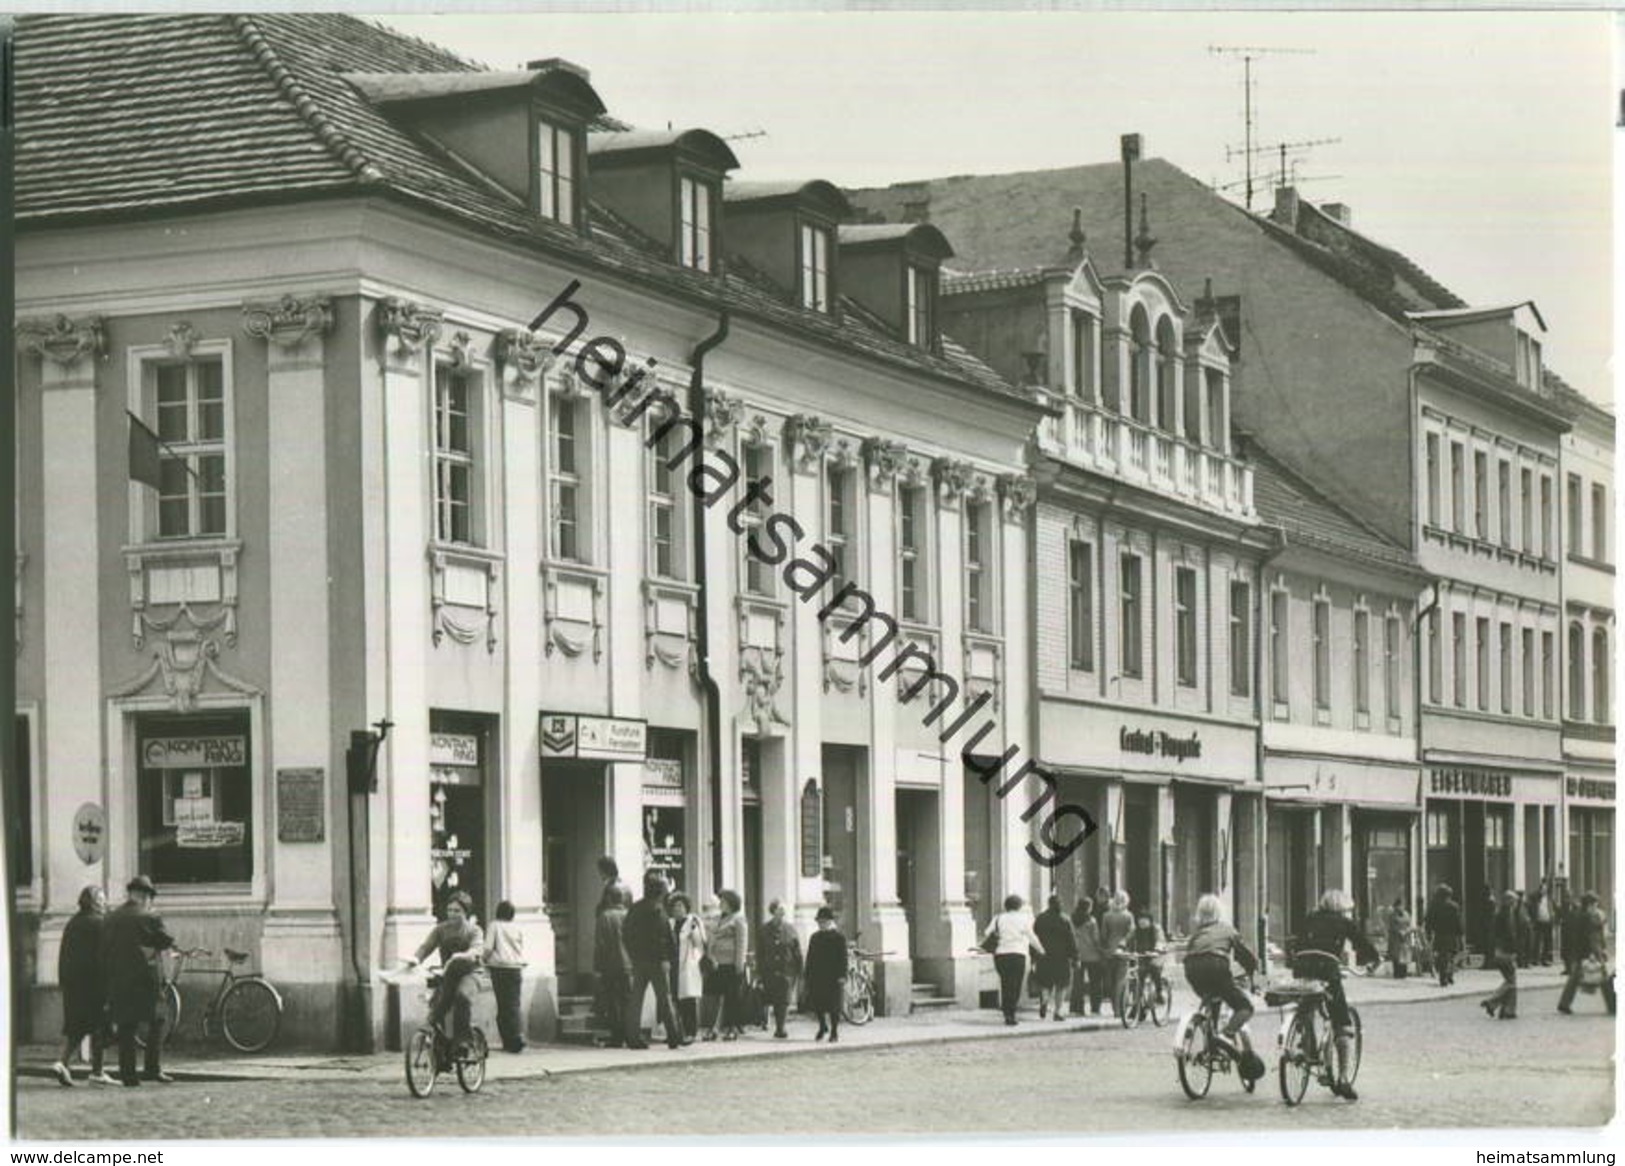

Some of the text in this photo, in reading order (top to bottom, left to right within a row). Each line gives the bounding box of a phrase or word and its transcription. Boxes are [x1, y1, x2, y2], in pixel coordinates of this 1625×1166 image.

[167, 739, 241, 756] KONTAKT
[431, 737, 475, 750] KONTAKT
[203, 749, 242, 764] RING
[453, 748, 475, 762] RING
[662, 770, 681, 784] RING
[1431, 768, 1512, 797] EISENWAREN
